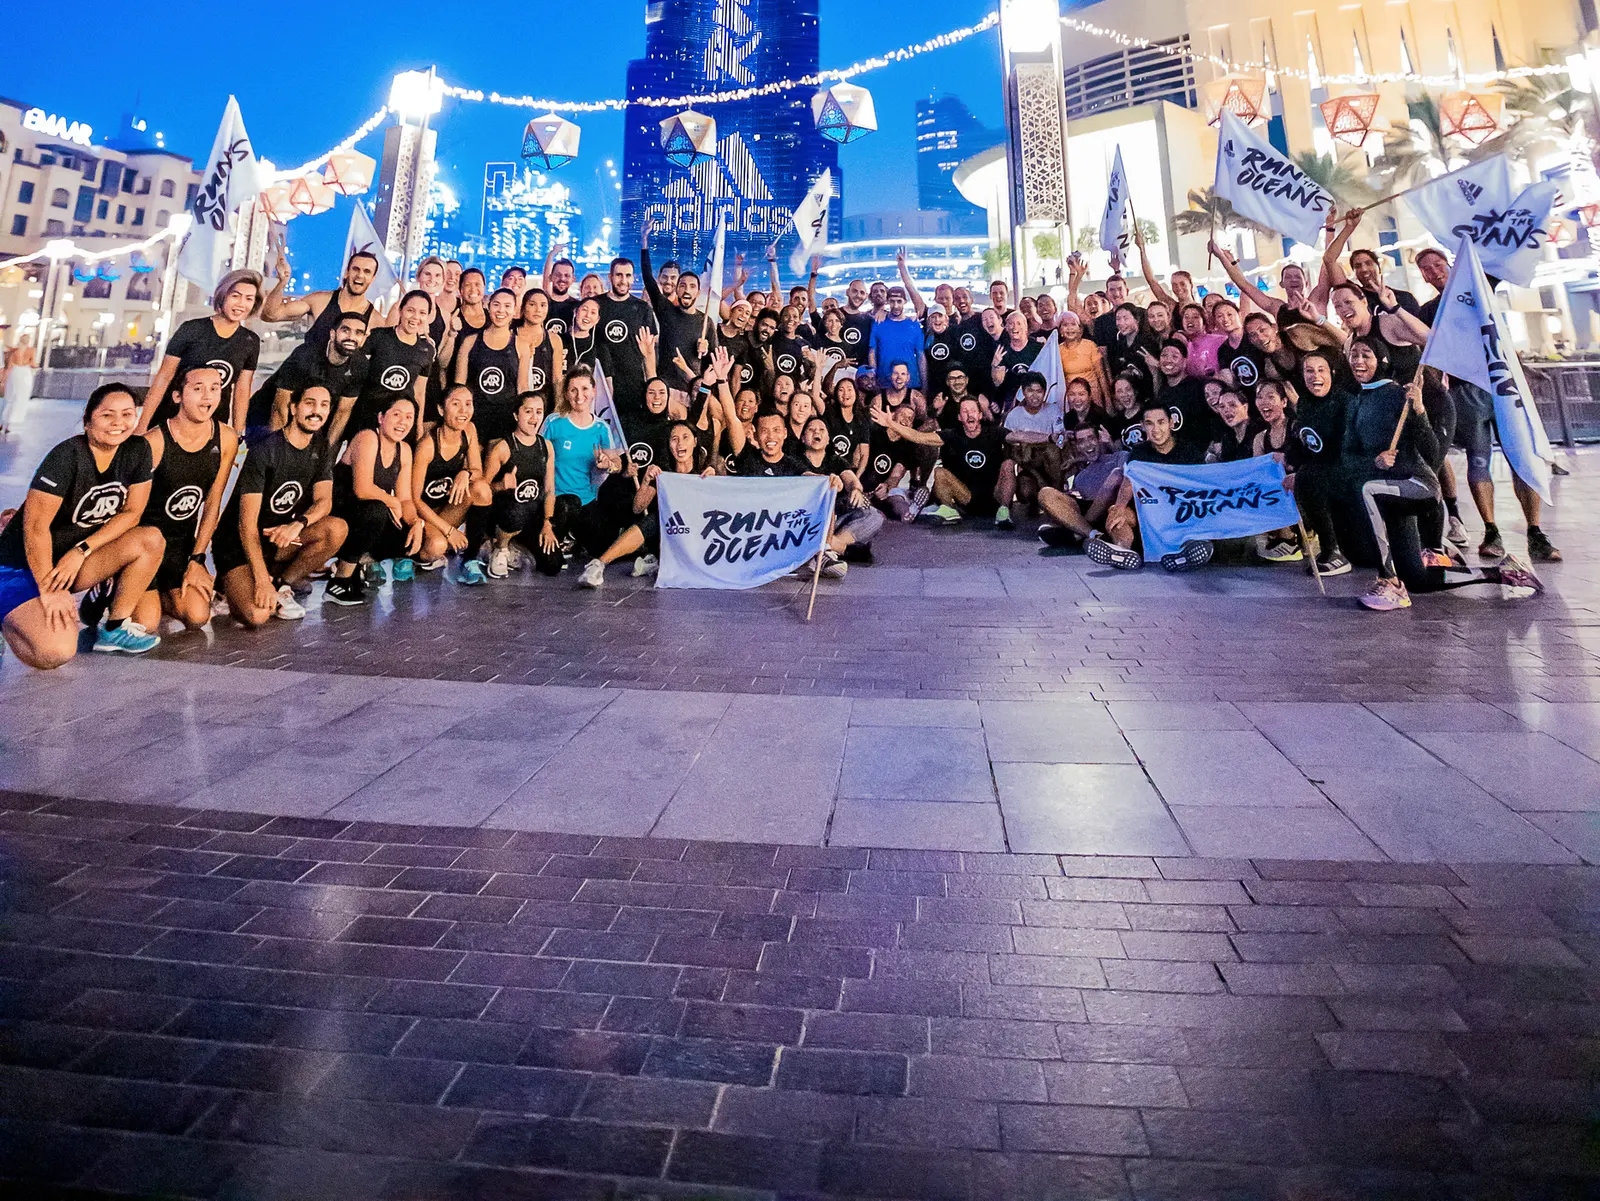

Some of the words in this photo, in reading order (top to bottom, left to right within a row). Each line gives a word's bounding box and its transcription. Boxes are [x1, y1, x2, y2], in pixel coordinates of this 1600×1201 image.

[23, 107, 93, 147] EMAAR
[1241, 147, 1304, 181] RUN
[1236, 167, 1335, 212] OCEANS
[644, 196, 793, 235] adidas
[1510, 218, 1534, 226] THE
[700, 509, 783, 540] RUN
[782, 509, 812, 520] FOR
[787, 517, 811, 528] THE
[703, 522, 821, 566] OCEANS
